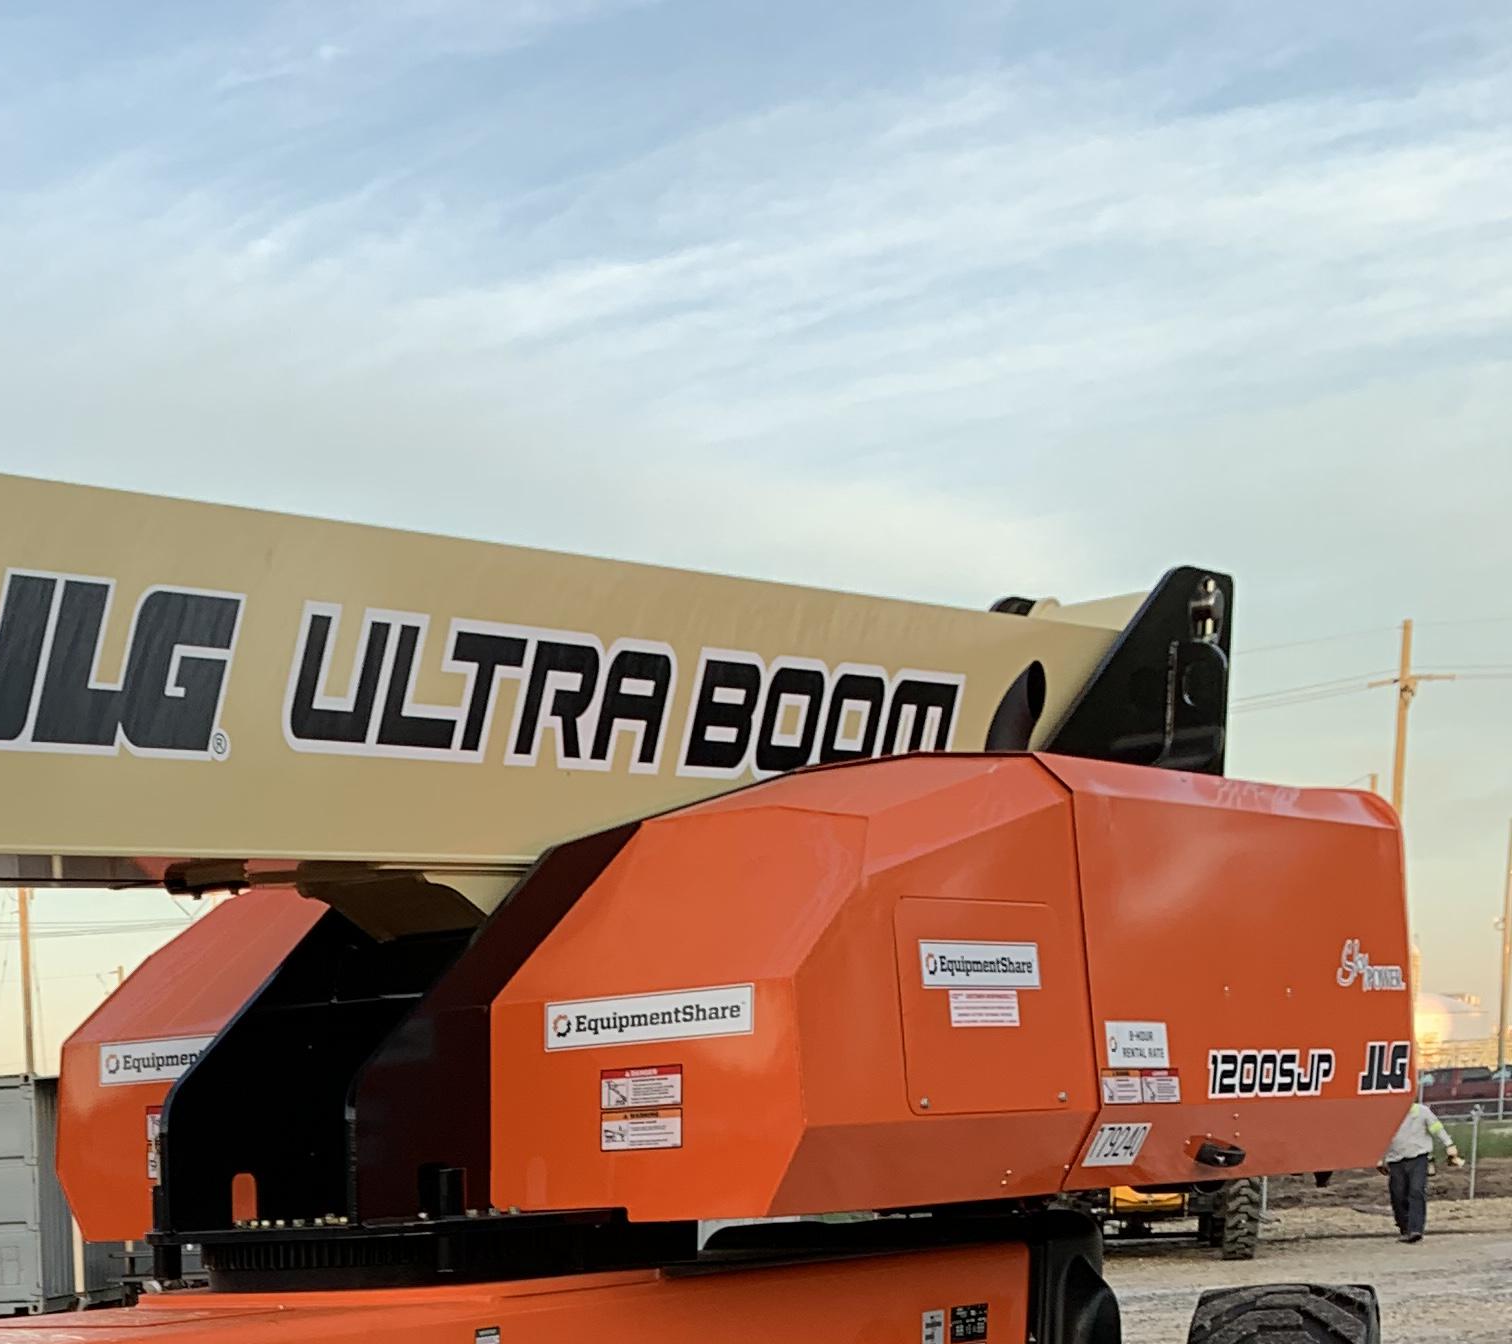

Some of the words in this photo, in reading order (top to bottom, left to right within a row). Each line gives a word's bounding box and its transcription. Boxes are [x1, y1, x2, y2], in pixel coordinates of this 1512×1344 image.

[292, 612, 672, 763] ULTRA
[684, 658, 963, 770] BOOM
[938, 955, 1033, 977] EquipmentShare
[575, 1002, 741, 1035] EquipmentShare
[1122, 1047, 1147, 1059] RENTAL
[1148, 1047, 1165, 1059] RATE
[1210, 1051, 1335, 1096] 1200SJP
[1358, 1042, 1411, 1093] JLG
[1089, 1126, 1149, 1158] 179240
